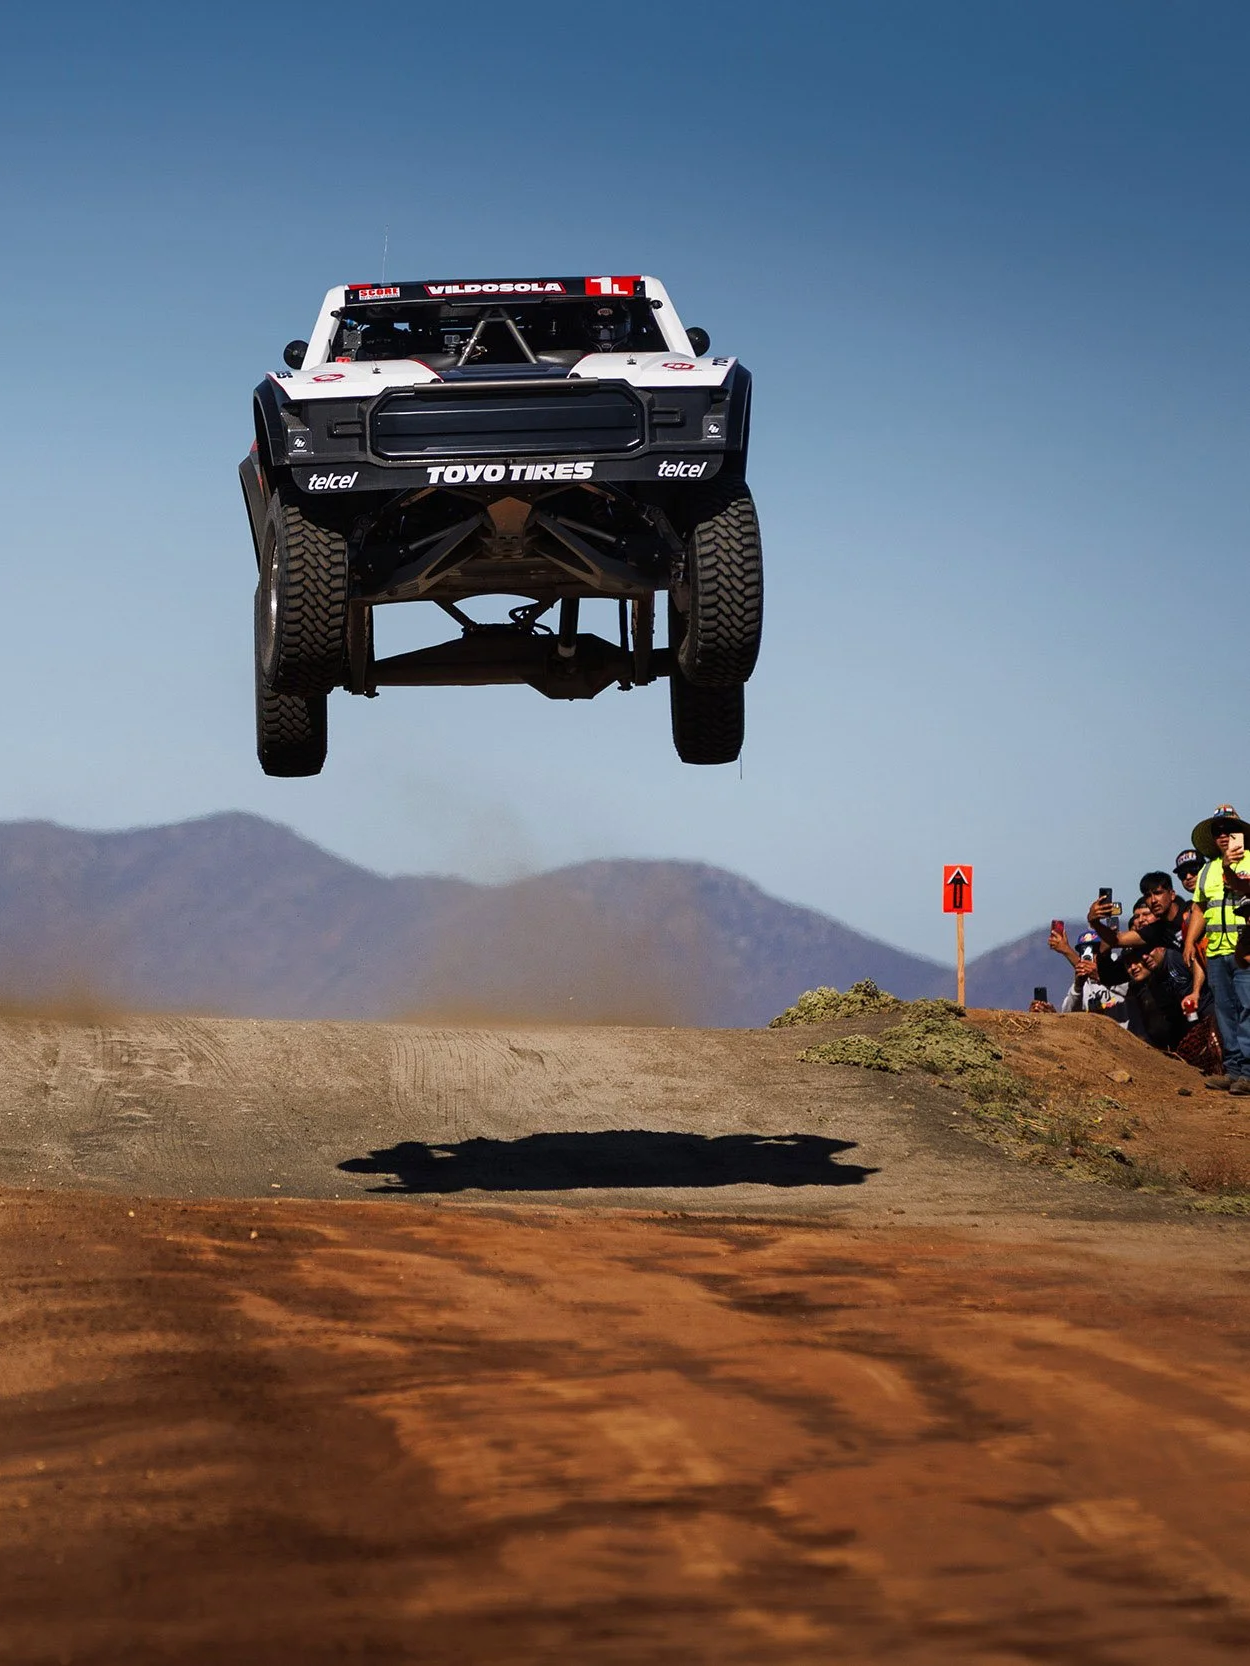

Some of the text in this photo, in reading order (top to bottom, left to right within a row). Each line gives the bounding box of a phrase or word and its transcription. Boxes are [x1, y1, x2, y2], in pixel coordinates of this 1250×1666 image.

[360, 287, 398, 297] SCORE
[427, 283, 562, 294] VILDOSOLA
[590, 276, 628, 295] 1L
[426, 461, 595, 484] TOYO TIRES
[657, 460, 708, 478] telcel
[308, 471, 359, 491] telcel
